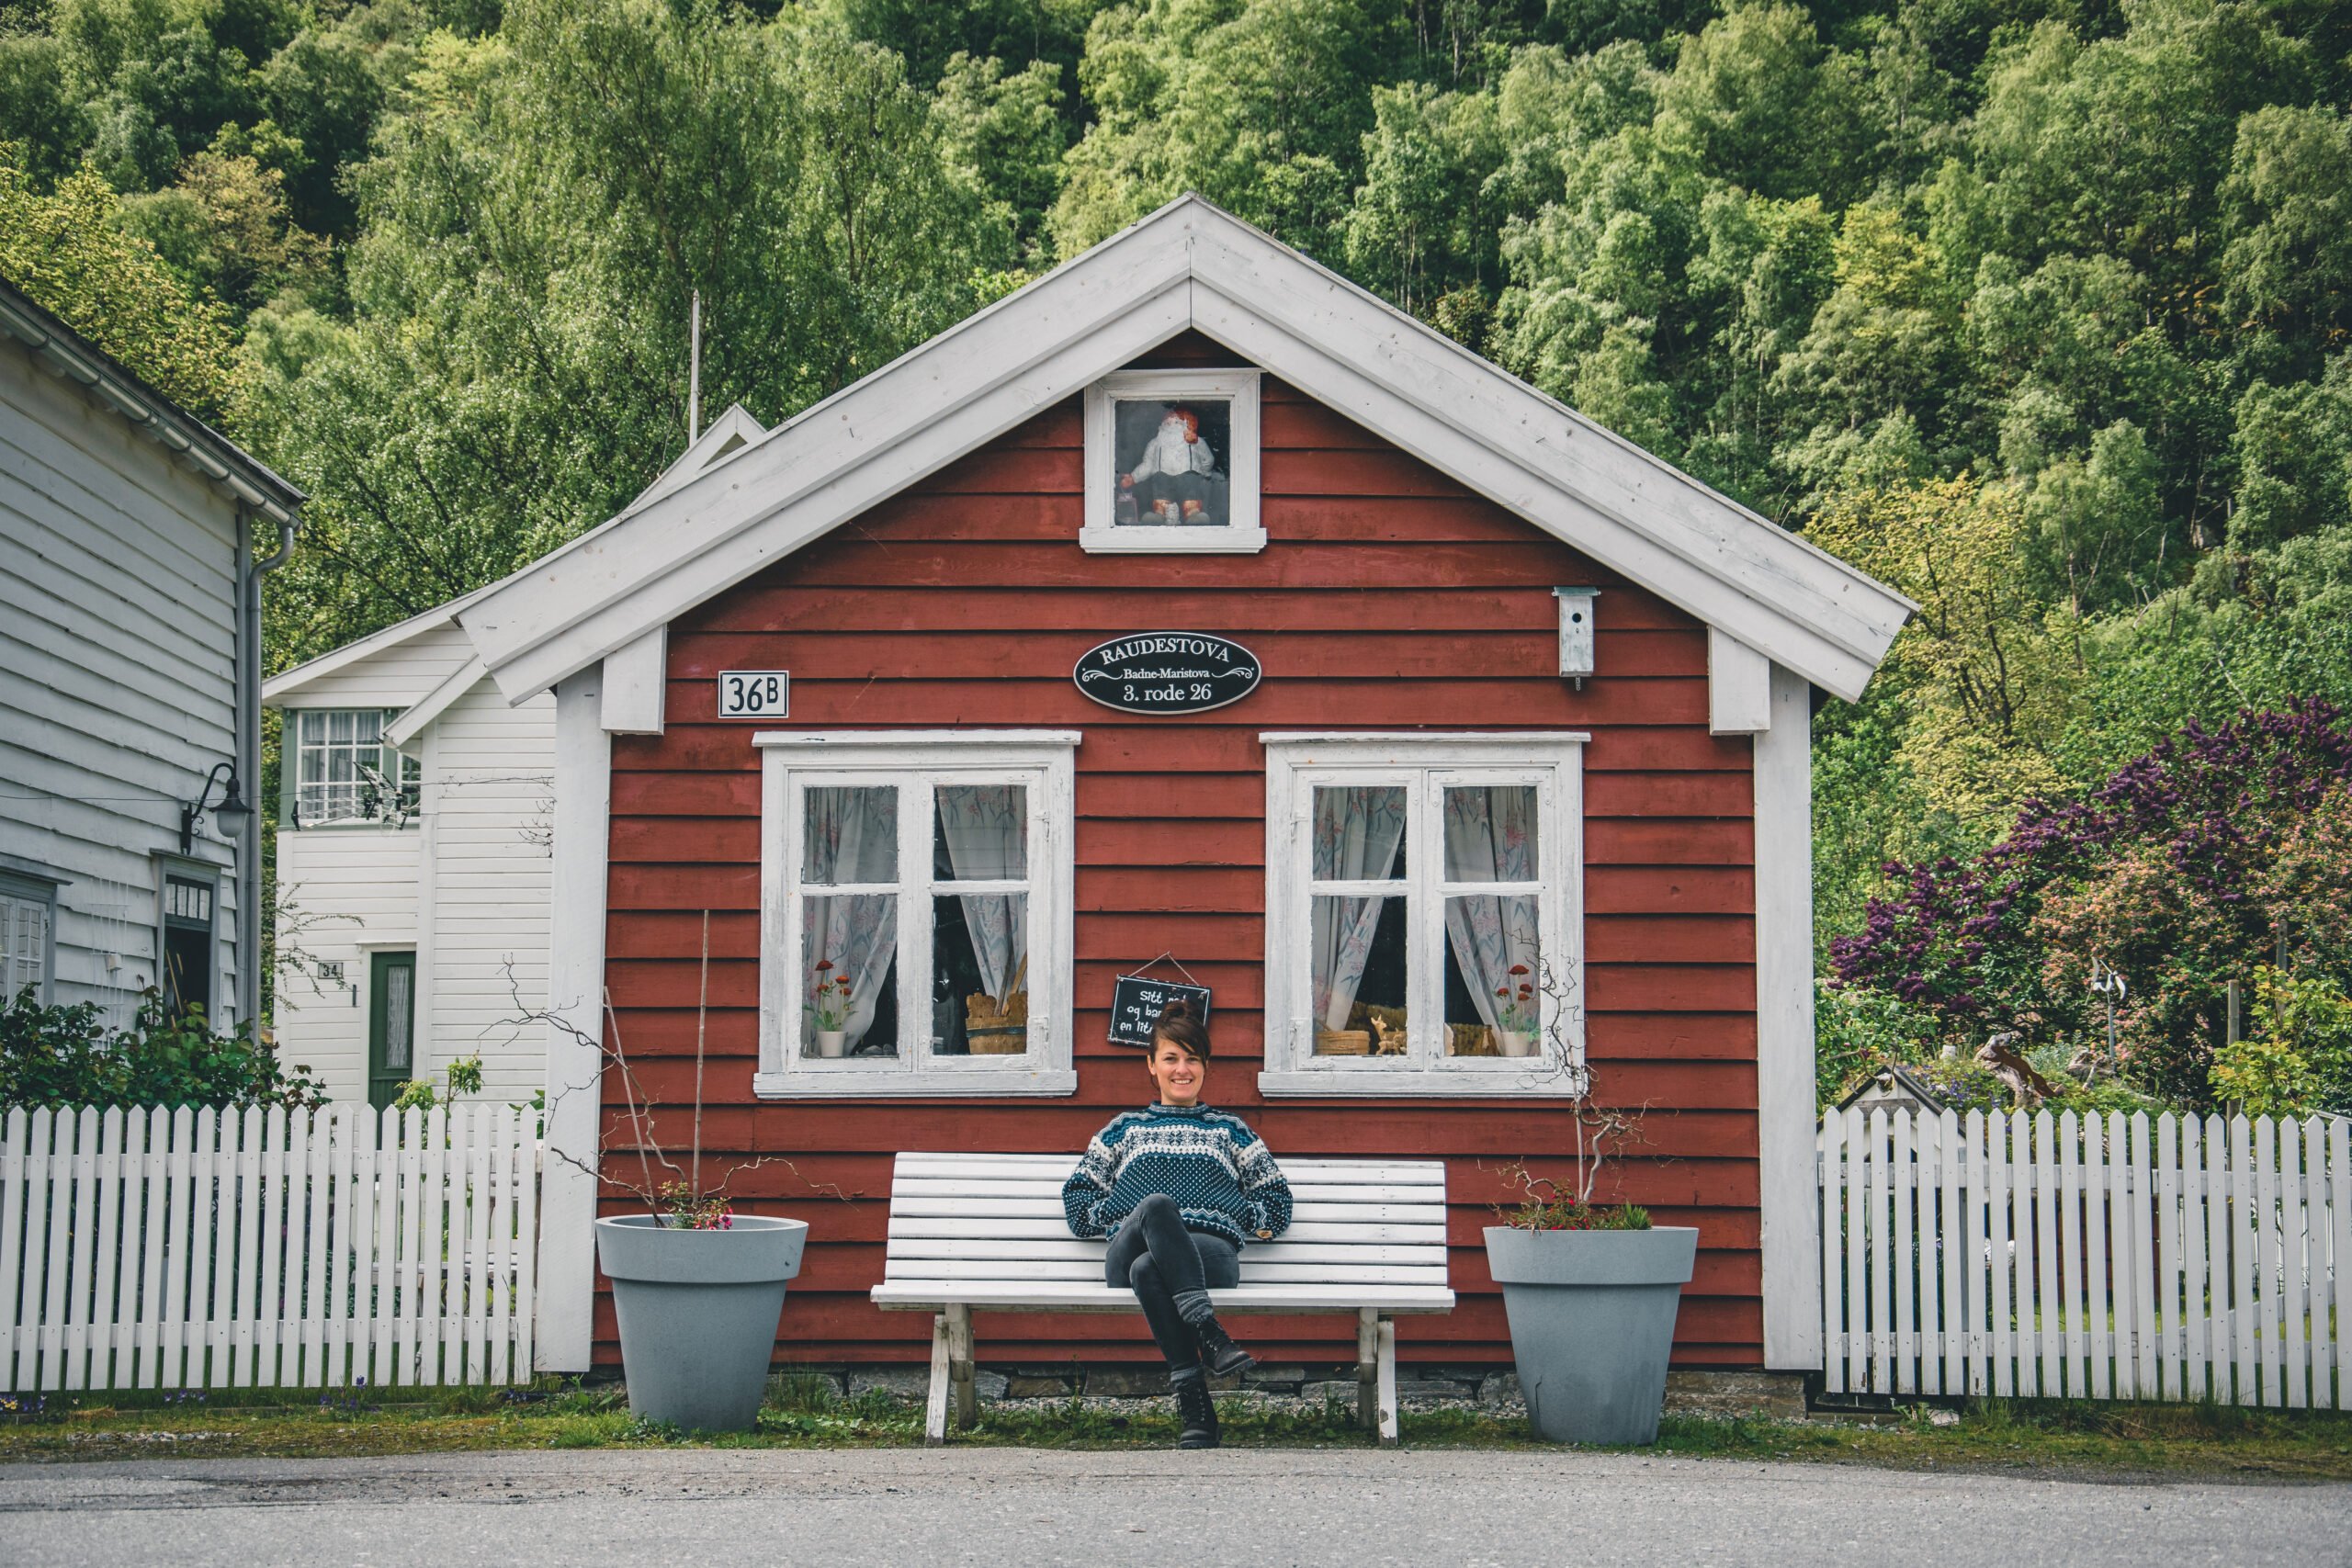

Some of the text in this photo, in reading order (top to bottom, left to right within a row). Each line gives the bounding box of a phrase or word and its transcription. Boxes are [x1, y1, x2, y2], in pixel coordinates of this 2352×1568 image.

[1100, 637, 1229, 665] RAUDESTOVA
[1123, 668, 1210, 679] Badne-Maristova
[729, 677, 778, 711] 36B
[1124, 683, 1212, 701] 3. rode 26
[322, 964, 337, 976] 34
[1139, 990, 1163, 1003] Sitt
[1126, 1006, 1140, 1021] og
[1120, 1021, 1132, 1031] en
